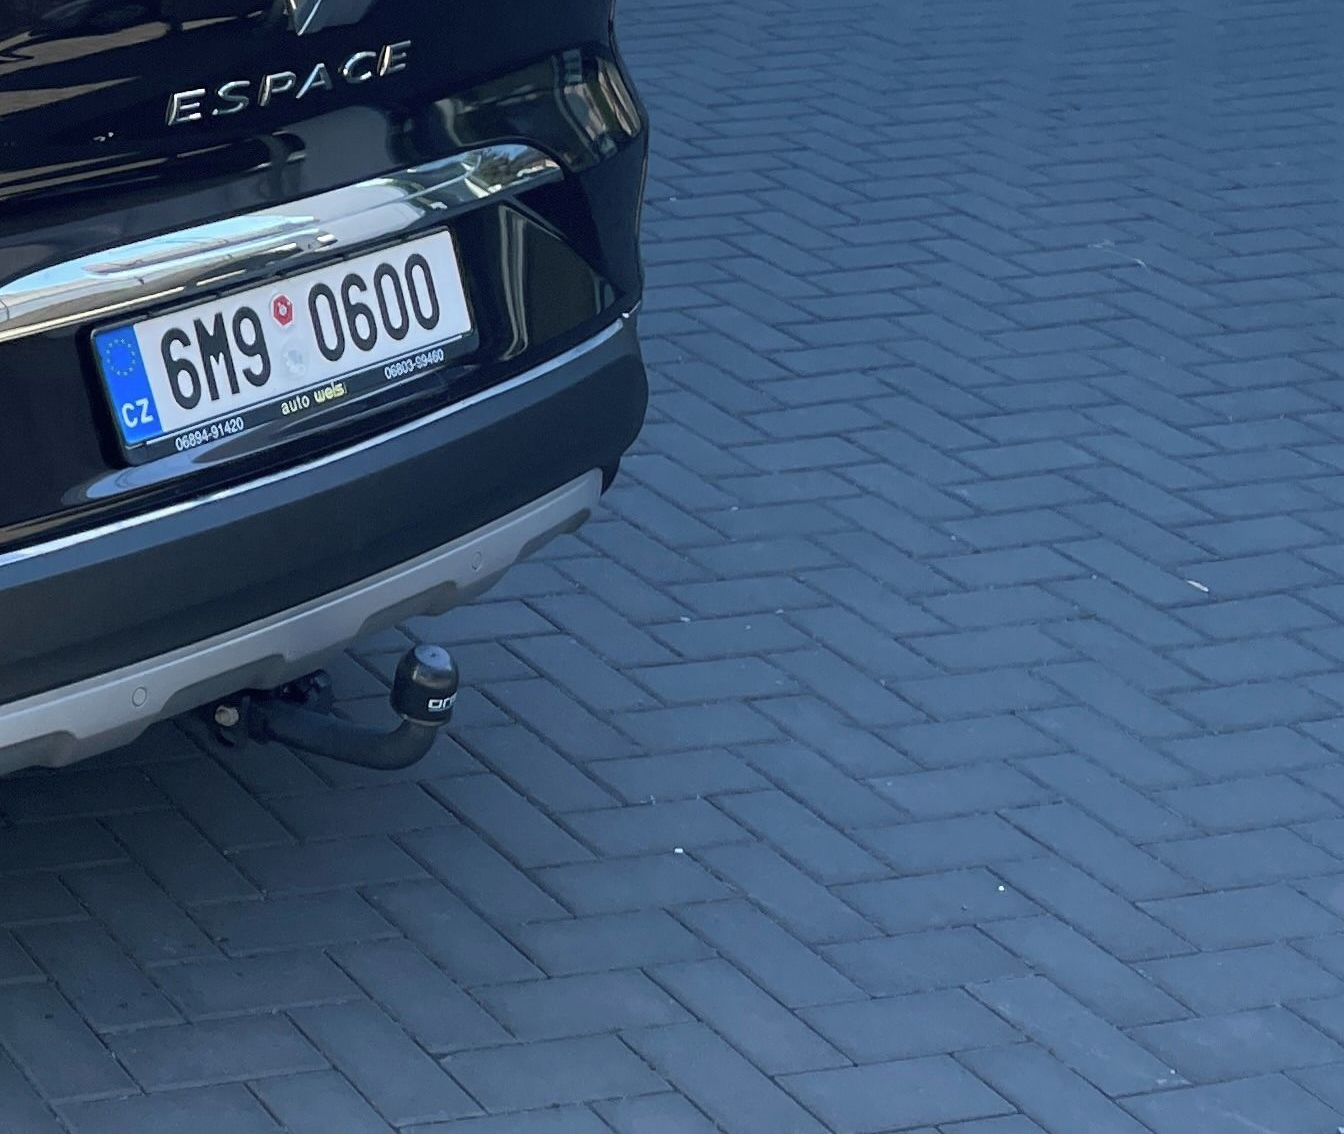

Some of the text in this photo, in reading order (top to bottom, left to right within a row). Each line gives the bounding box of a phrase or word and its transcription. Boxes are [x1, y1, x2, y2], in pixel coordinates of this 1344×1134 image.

[165, 40, 411, 126] ESPACE
[160, 253, 440, 410] 6M9 0600
[121, 397, 153, 428] CZ
[280, 394, 310, 416] auto
